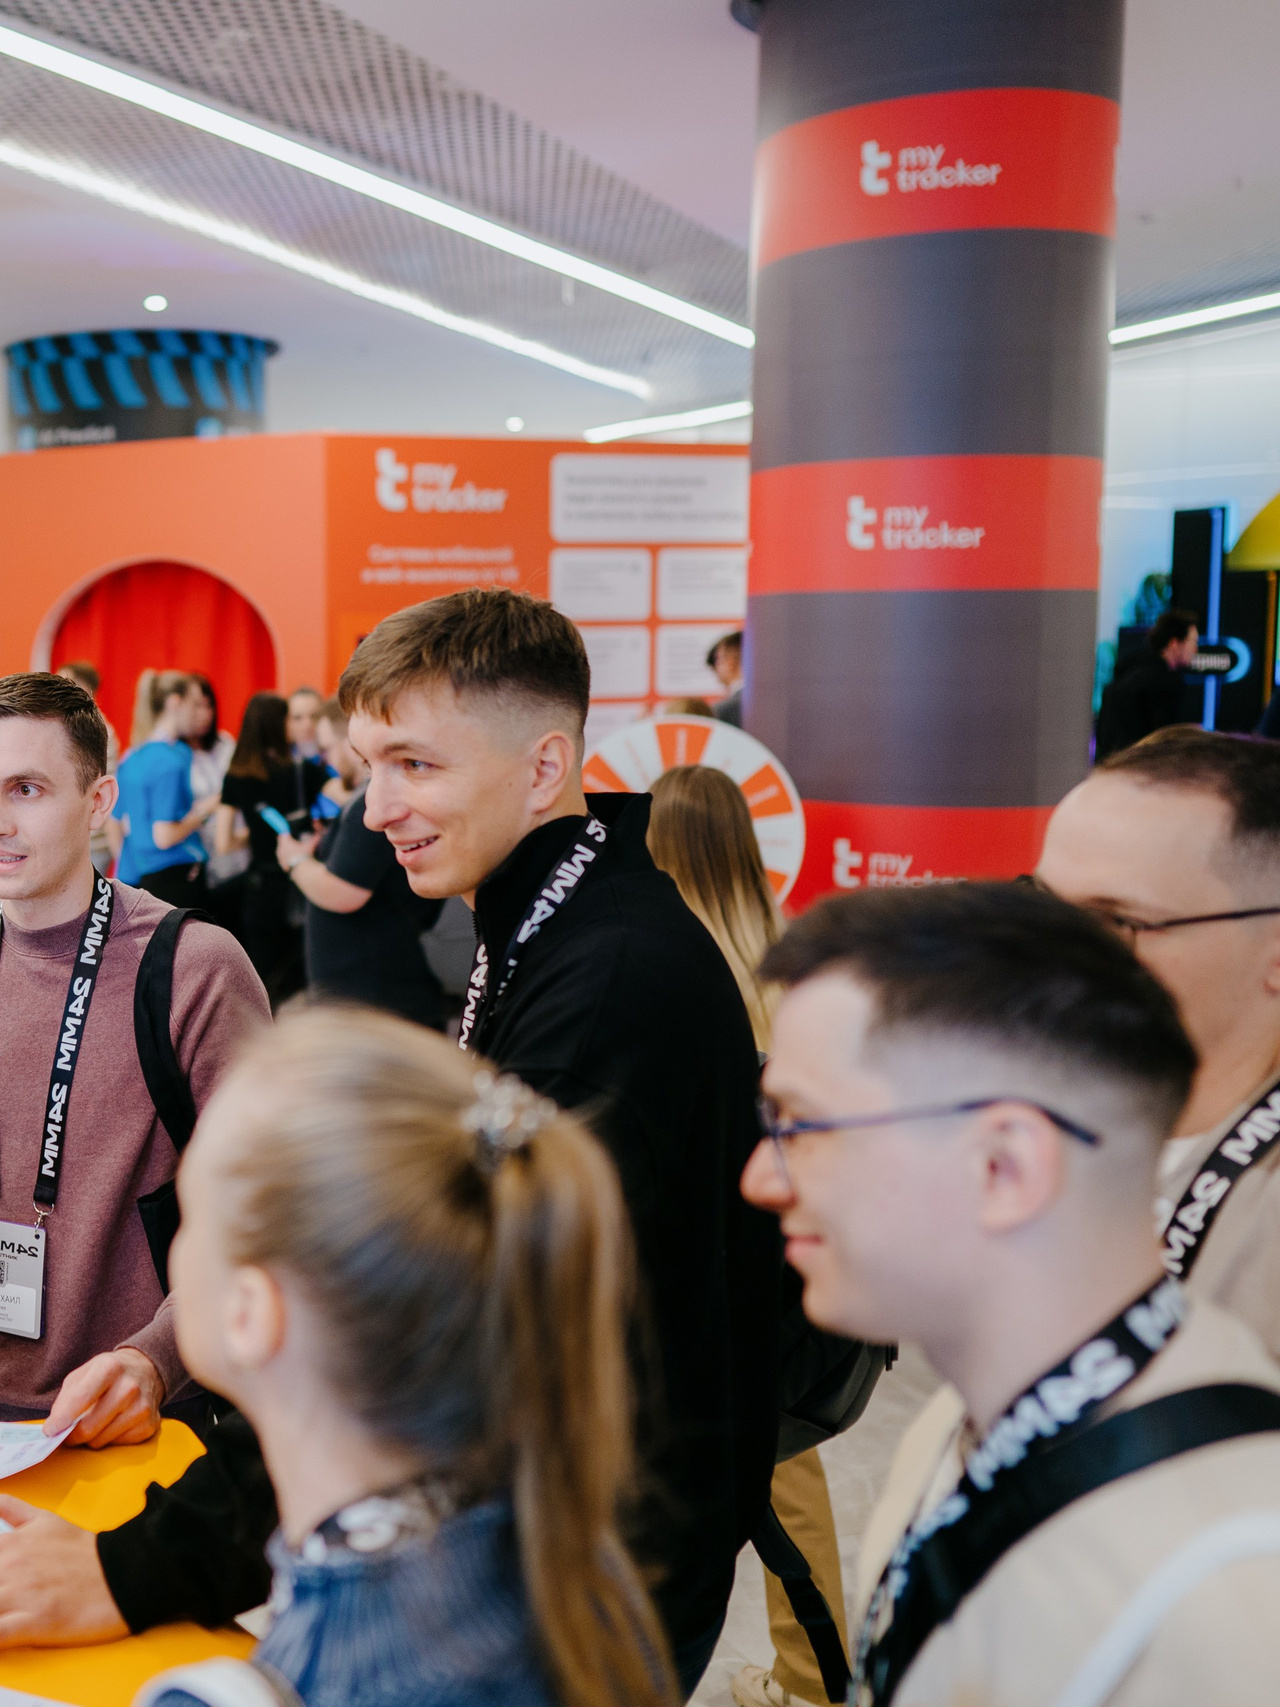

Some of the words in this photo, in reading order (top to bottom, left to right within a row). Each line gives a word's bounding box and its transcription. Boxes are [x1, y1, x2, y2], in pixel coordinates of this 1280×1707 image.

[898, 144, 945, 174] my
[896, 158, 1002, 193] tracker
[883, 505, 929, 531] my
[881, 520, 986, 550] tracker
